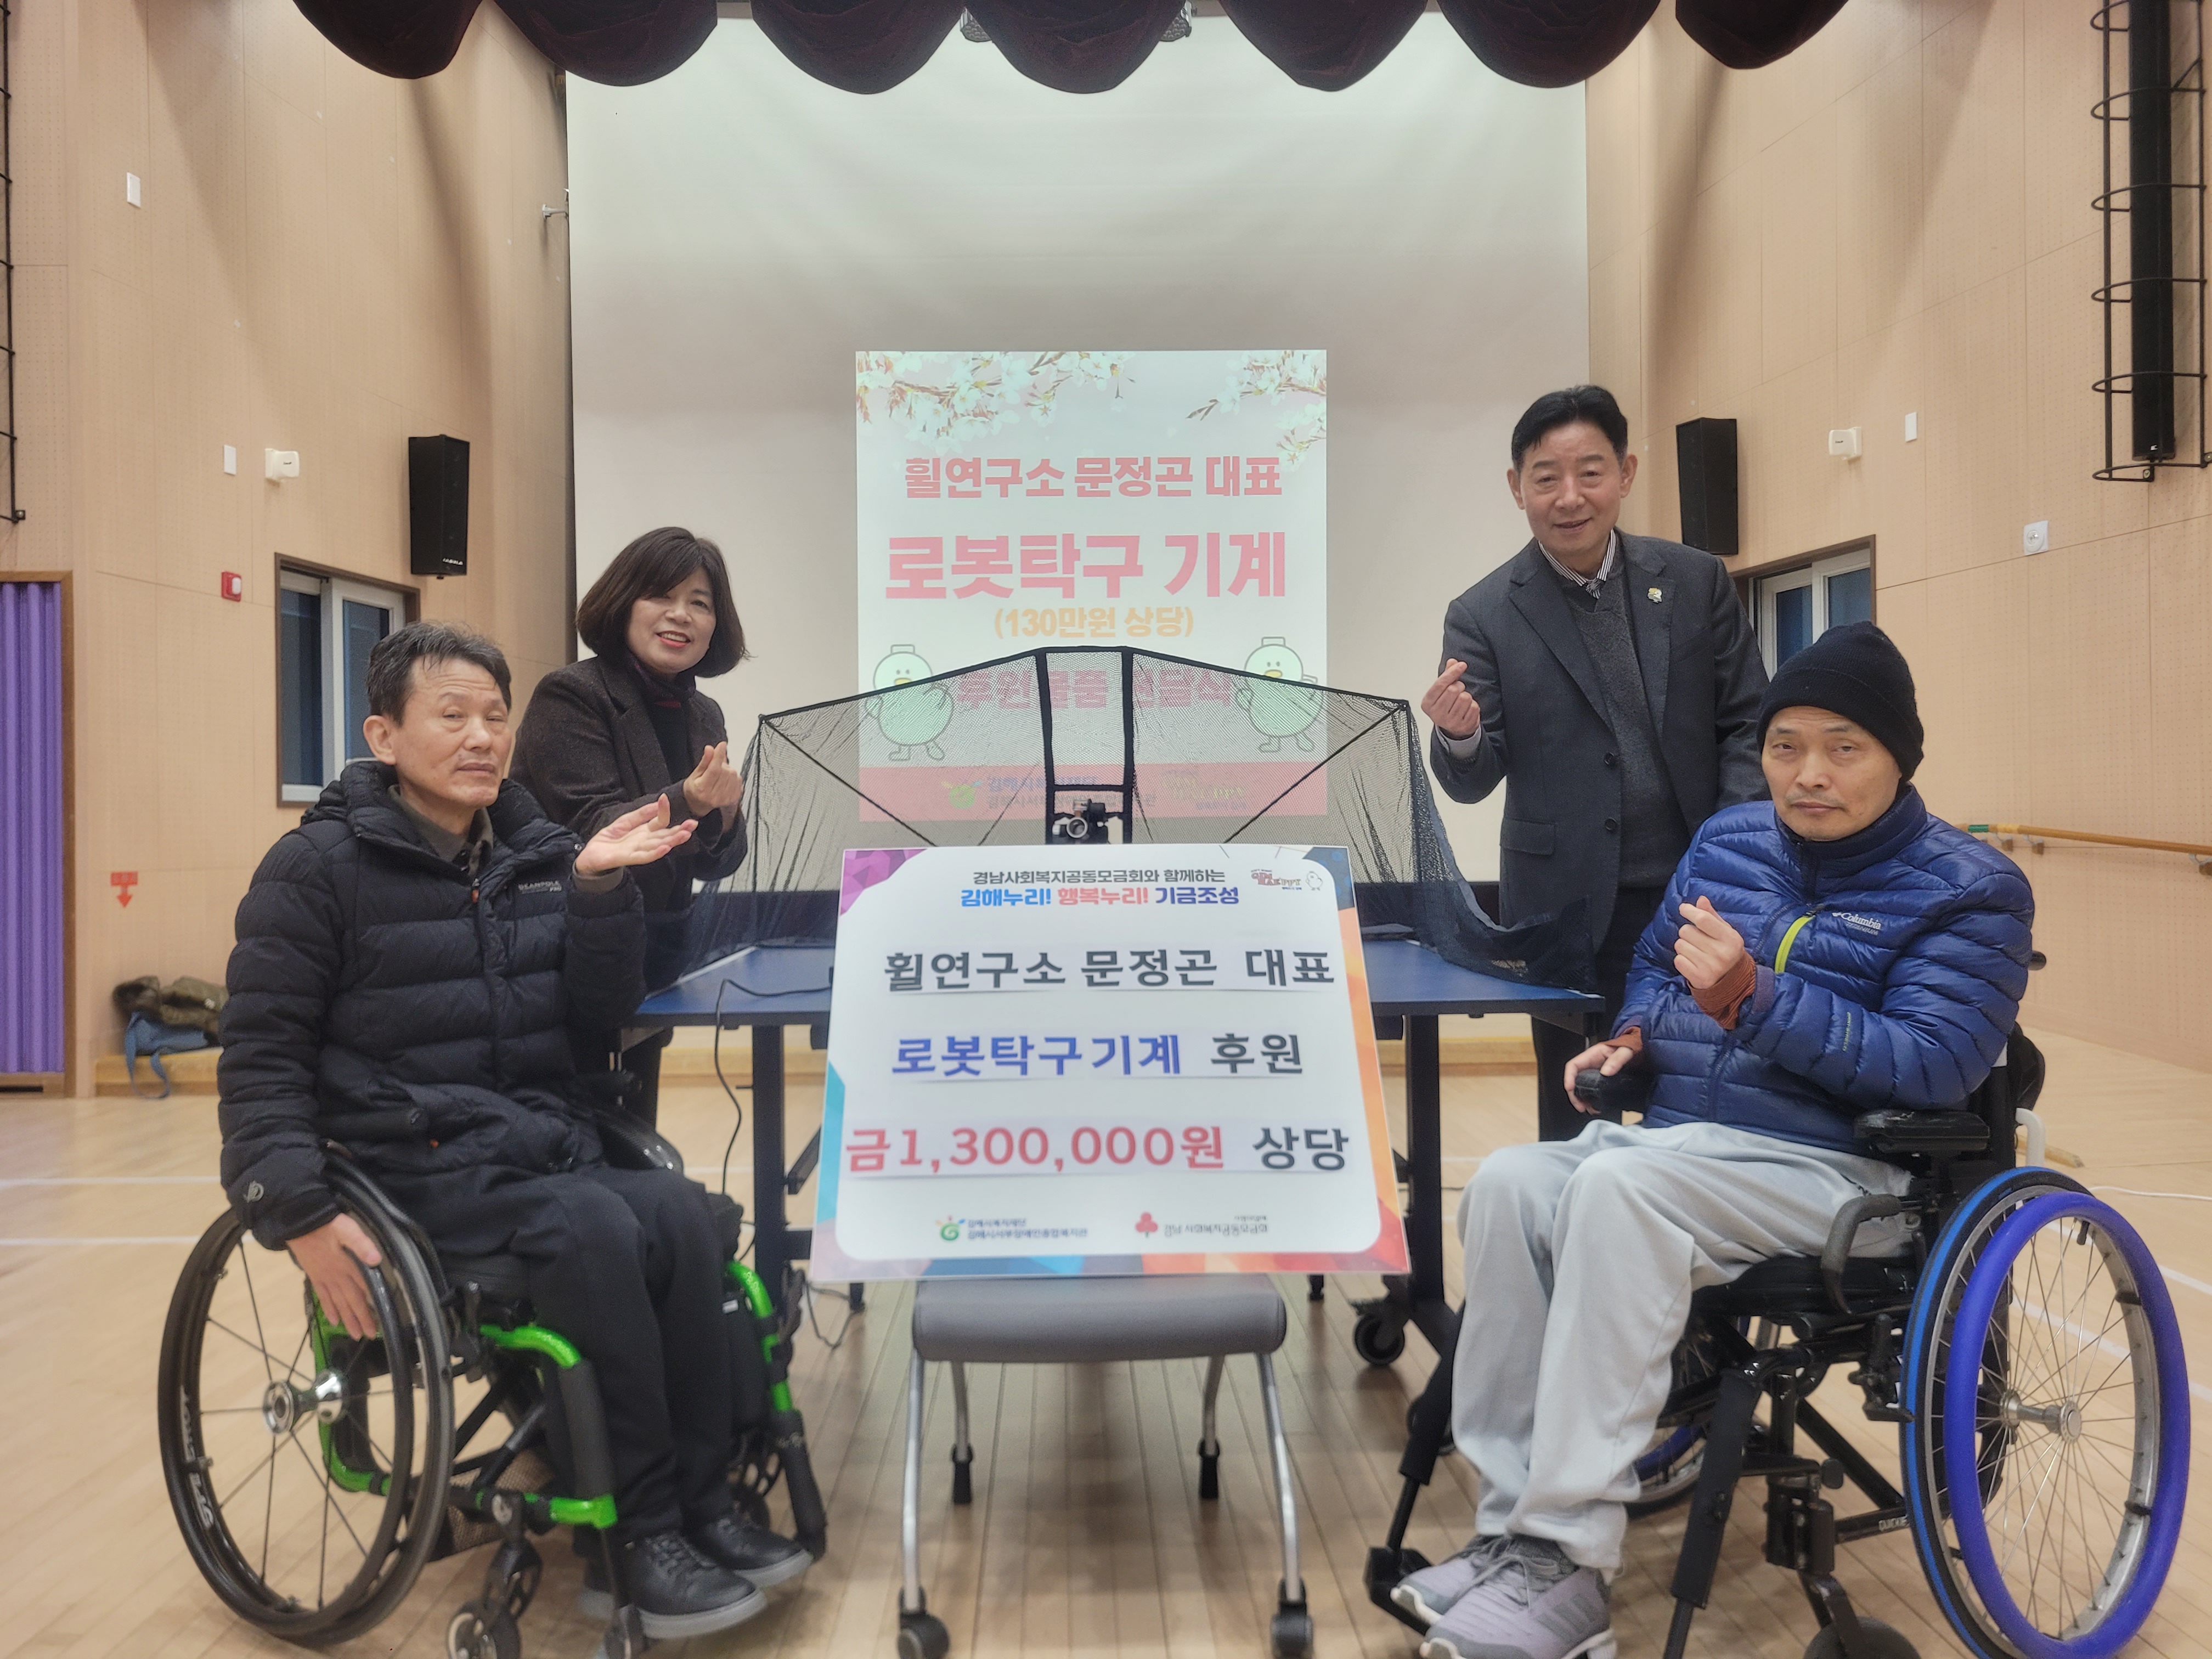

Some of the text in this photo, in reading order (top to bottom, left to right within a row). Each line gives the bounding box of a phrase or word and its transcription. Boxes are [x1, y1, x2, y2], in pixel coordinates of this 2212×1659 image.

[905, 455, 1283, 499] 휠연구소 문정곤 대표
[885, 531, 1286, 600] 로봇탁구 기계
[994, 605, 1194, 639] (130만원 상당)
[961, 886, 1240, 907] 김해누리! 행복누리! 기금조성
[973, 869, 1226, 885] 경남사회복지공동모금회와 함께하는
[1841, 912, 1881, 929] Columbia
[884, 949, 1335, 992] 휠연구소 문정곤 대표
[891, 1033, 1303, 1076] 로봇탁구기계 후원
[845, 1126, 1350, 1173] 금1,300,000원 상당
